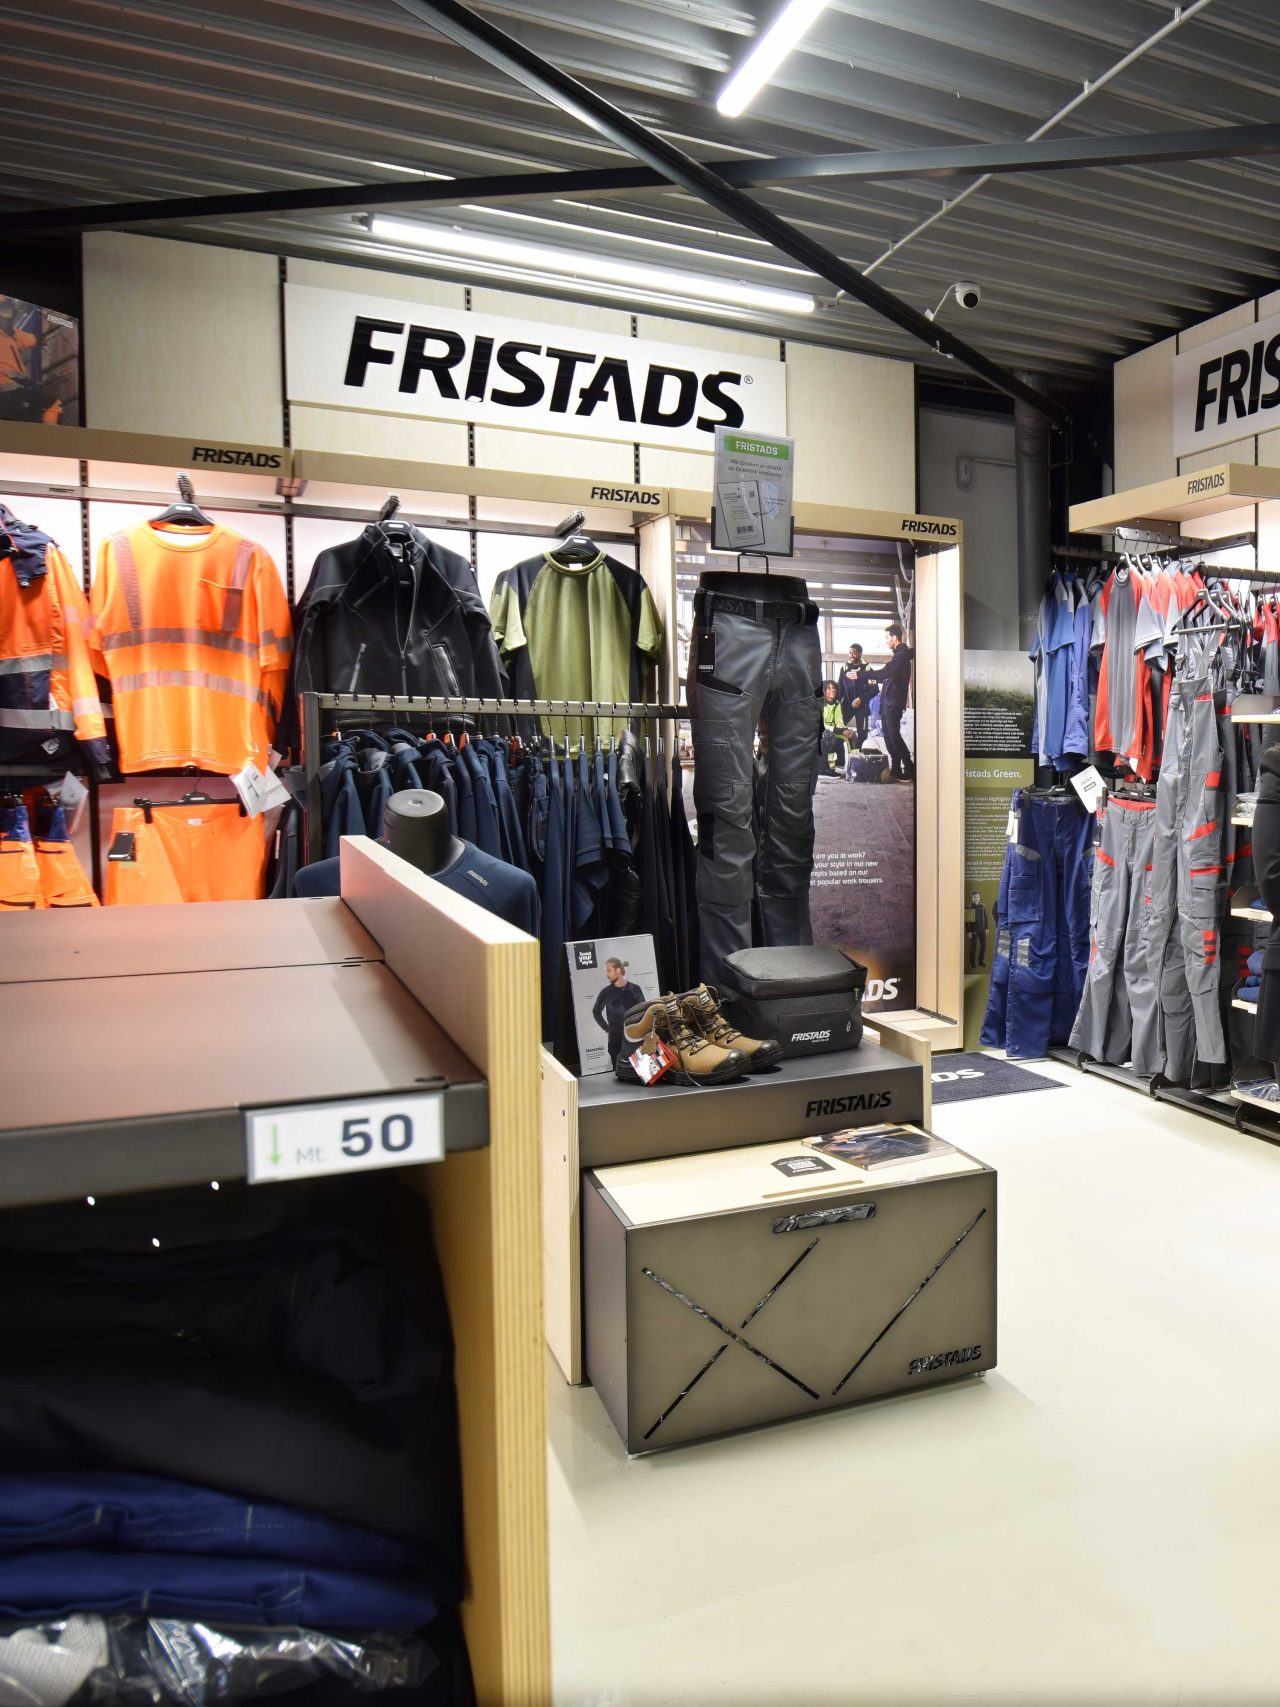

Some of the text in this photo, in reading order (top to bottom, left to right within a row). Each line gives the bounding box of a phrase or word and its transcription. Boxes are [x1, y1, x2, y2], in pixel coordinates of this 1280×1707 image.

[344, 316, 745, 433] FRISTADS
[736, 441, 778, 455] FRISTADS
[192, 447, 282, 468] FRISTADS
[1187, 472, 1225, 495] FRISTADS
[590, 487, 660, 505] FRISTADS
[902, 519, 957, 536] FRISTADS
[965, 666, 1023, 680] RISTADS
[993, 769, 1022, 778] Green.
[830, 861, 845, 869] style
[828, 869, 847, 877] based
[817, 878, 841, 886] popular
[791, 1029, 832, 1042] FRISTADS
[806, 1091, 891, 1118] FRISTADS
[341, 1114, 413, 1157] 50
